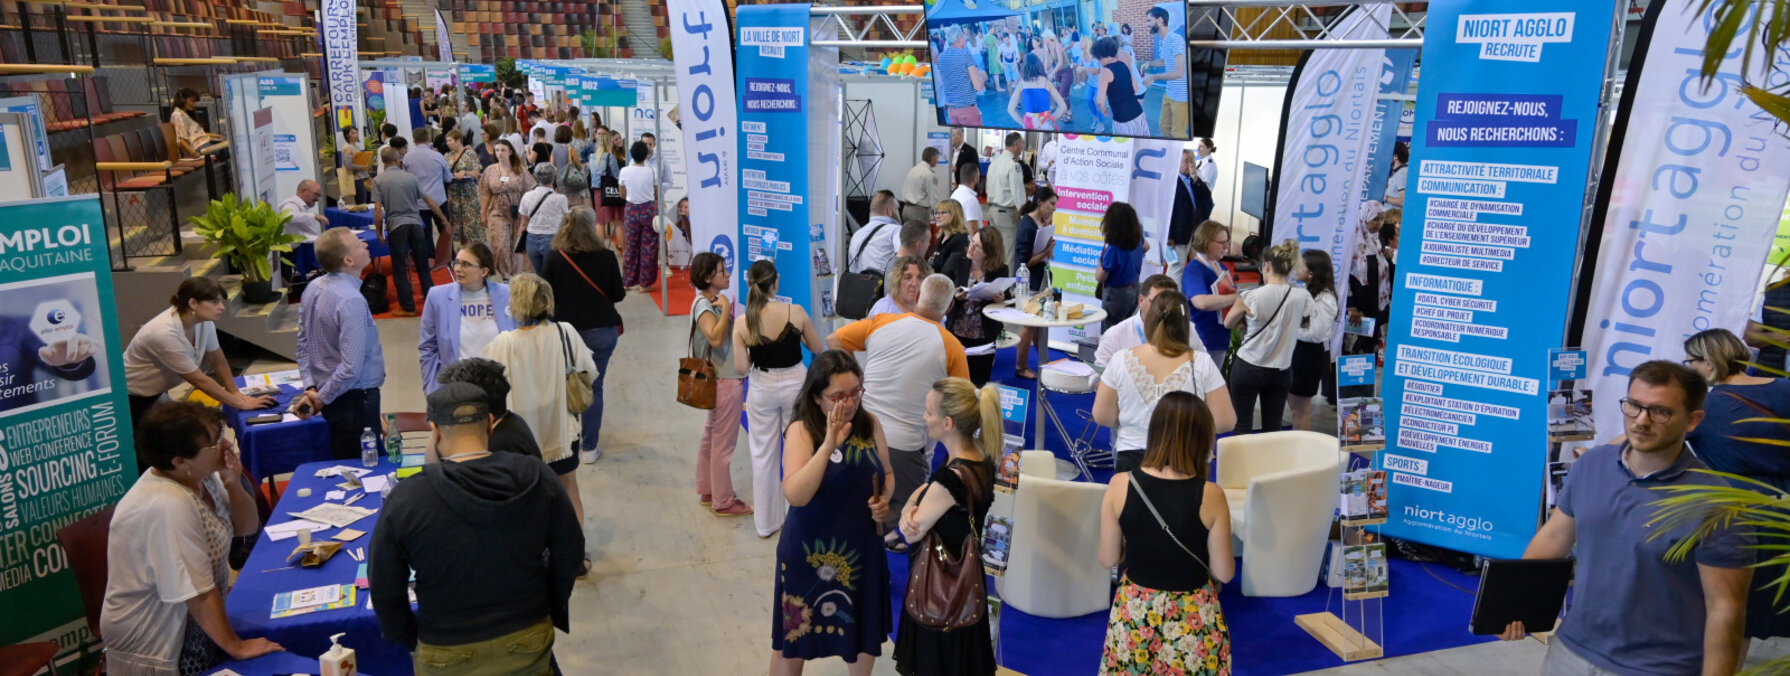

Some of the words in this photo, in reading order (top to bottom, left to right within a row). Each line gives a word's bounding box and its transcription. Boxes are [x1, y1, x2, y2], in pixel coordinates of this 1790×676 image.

[1463, 20, 1511, 38] NIORT
[1514, 18, 1567, 37] AGGLO
[743, 30, 751, 43] LA
[753, 30, 770, 43] VILLE
[771, 31, 780, 43] DE
[782, 31, 800, 43] NIORT
[761, 45, 783, 56] RECRUTE
[1485, 43, 1537, 58] RECRUTE
[582, 80, 598, 91] B02
[747, 99, 760, 109] NOUS
[1345, 66, 1367, 141] Niortais
[1447, 101, 1549, 117] REJOIGNEZ-NOUS,
[1301, 69, 1343, 195] agglo
[1437, 128, 1467, 141] NOUS
[1470, 127, 1557, 141] RECHERCHONS
[1060, 145, 1085, 155] Centre
[1086, 147, 1129, 158] Communal
[1736, 136, 1768, 172] du
[1063, 157, 1094, 167] d'Action
[1095, 159, 1124, 169] Sociale
[1423, 163, 1485, 177] ATTRACTIVITÉ
[1488, 166, 1554, 180] TERRITORIALE
[1057, 188, 1110, 202] Intervention
[1421, 180, 1497, 195] COMMUNICATION
[1076, 202, 1109, 212] sociale
[1428, 208, 1474, 219] COMMERCIALE
[1460, 201, 1469, 210] DE
[1470, 202, 1520, 213] DYNAMISATION
[1457, 223, 1466, 232] DU
[1425, 230, 1434, 238] DE
[1434, 231, 1489, 242] L'ENSEIGNEMENT
[1424, 243, 1469, 254] #JOURNALISTE
[1072, 256, 1098, 266] social
[1422, 254, 1461, 266] #DIRECTEUR
[1462, 258, 1471, 266] DE
[1471, 259, 1500, 270] SERVICE
[1409, 275, 1474, 292] INFORMATIQUE
[1440, 297, 1461, 307] CYBER
[460, 303, 494, 318] NOPE
[1416, 307, 1436, 317] #CHEF
[1437, 308, 1445, 317] DE
[1446, 310, 1470, 321] PROJET
[1414, 319, 1466, 332] #COORDINATEUR
[1413, 328, 1457, 341] RESPONSABLE
[1401, 347, 1450, 364] TRANSITION
[1452, 351, 1508, 371] ÉCOLOGIQUE
[1398, 363, 1408, 374] ET
[1411, 364, 1486, 385] DÉVELOPPEMENT
[1487, 375, 1530, 391] DURABLE
[1405, 393, 1446, 407] #EXPLOITANT
[1447, 399, 1473, 411] STATION
[6, 407, 92, 450] ENTREPRENEURS
[1402, 418, 1446, 432] #CONDUCTEUR
[1447, 424, 1455, 434] PL
[90, 401, 123, 477] E-FORUM
[1399, 438, 1434, 451] NOUVELLES
[9, 446, 33, 468] WEB
[34, 431, 95, 461] CONFERENCE
[1387, 456, 1419, 471] SPORTS
[15, 450, 98, 500] SOURCING
[0, 472, 20, 530] SALONS
[20, 491, 71, 525] VALEURS
[70, 474, 126, 510] HUMAINES
[1404, 505, 1445, 523] niort
[1446, 514, 1493, 531] agglo
[1403, 518, 1452, 532] Agglomération
[1464, 530, 1492, 540] Niortais
